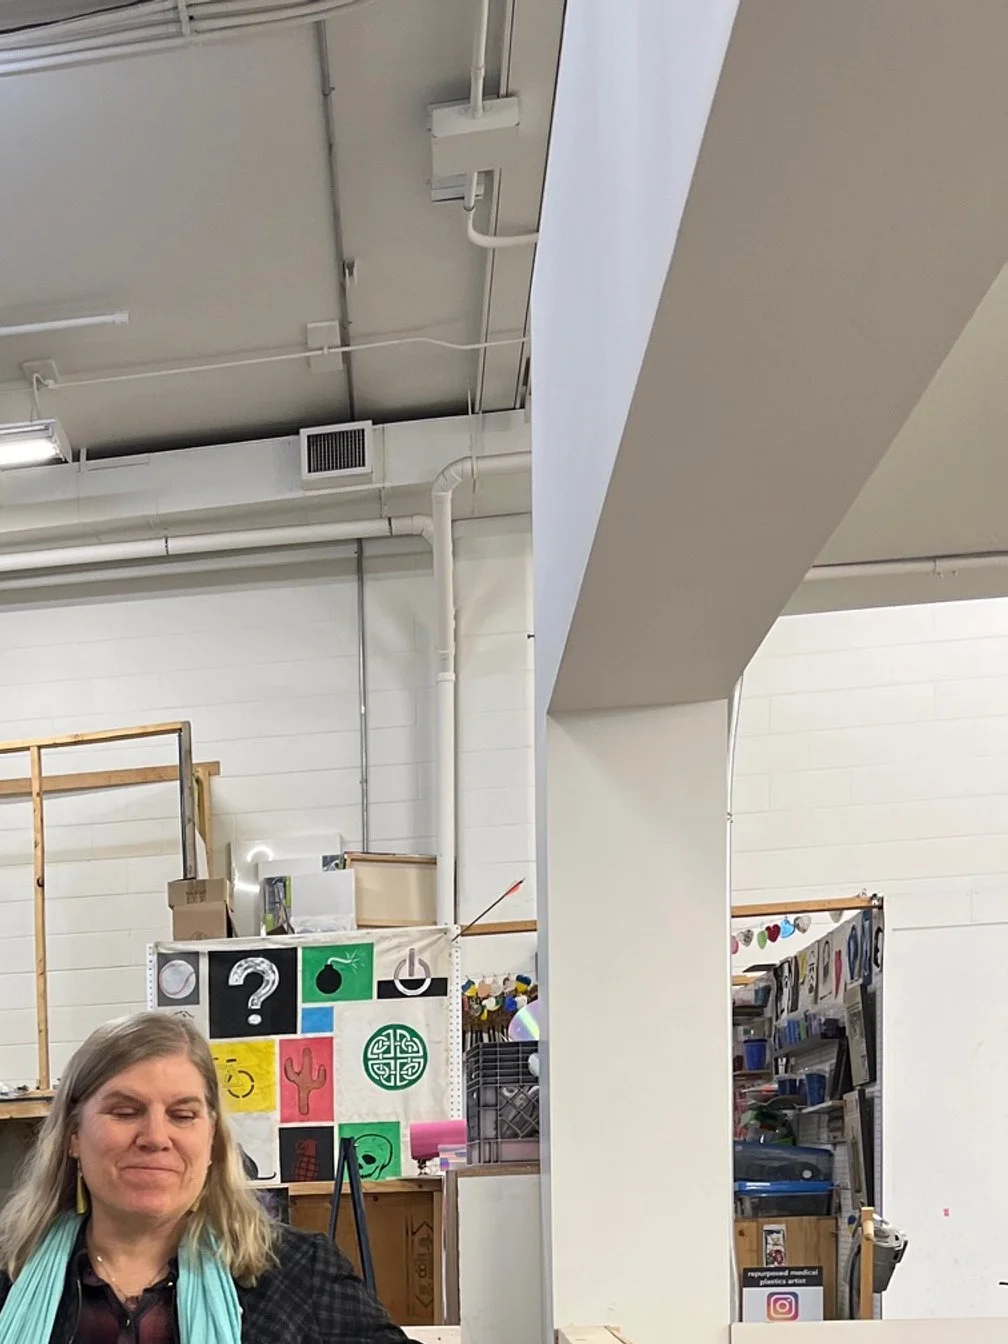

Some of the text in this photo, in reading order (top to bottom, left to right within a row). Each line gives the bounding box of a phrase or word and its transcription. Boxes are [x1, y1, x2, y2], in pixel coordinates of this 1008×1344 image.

[748, 1268, 819, 1279] repurposed medical
[760, 1278, 787, 1286] plastics
